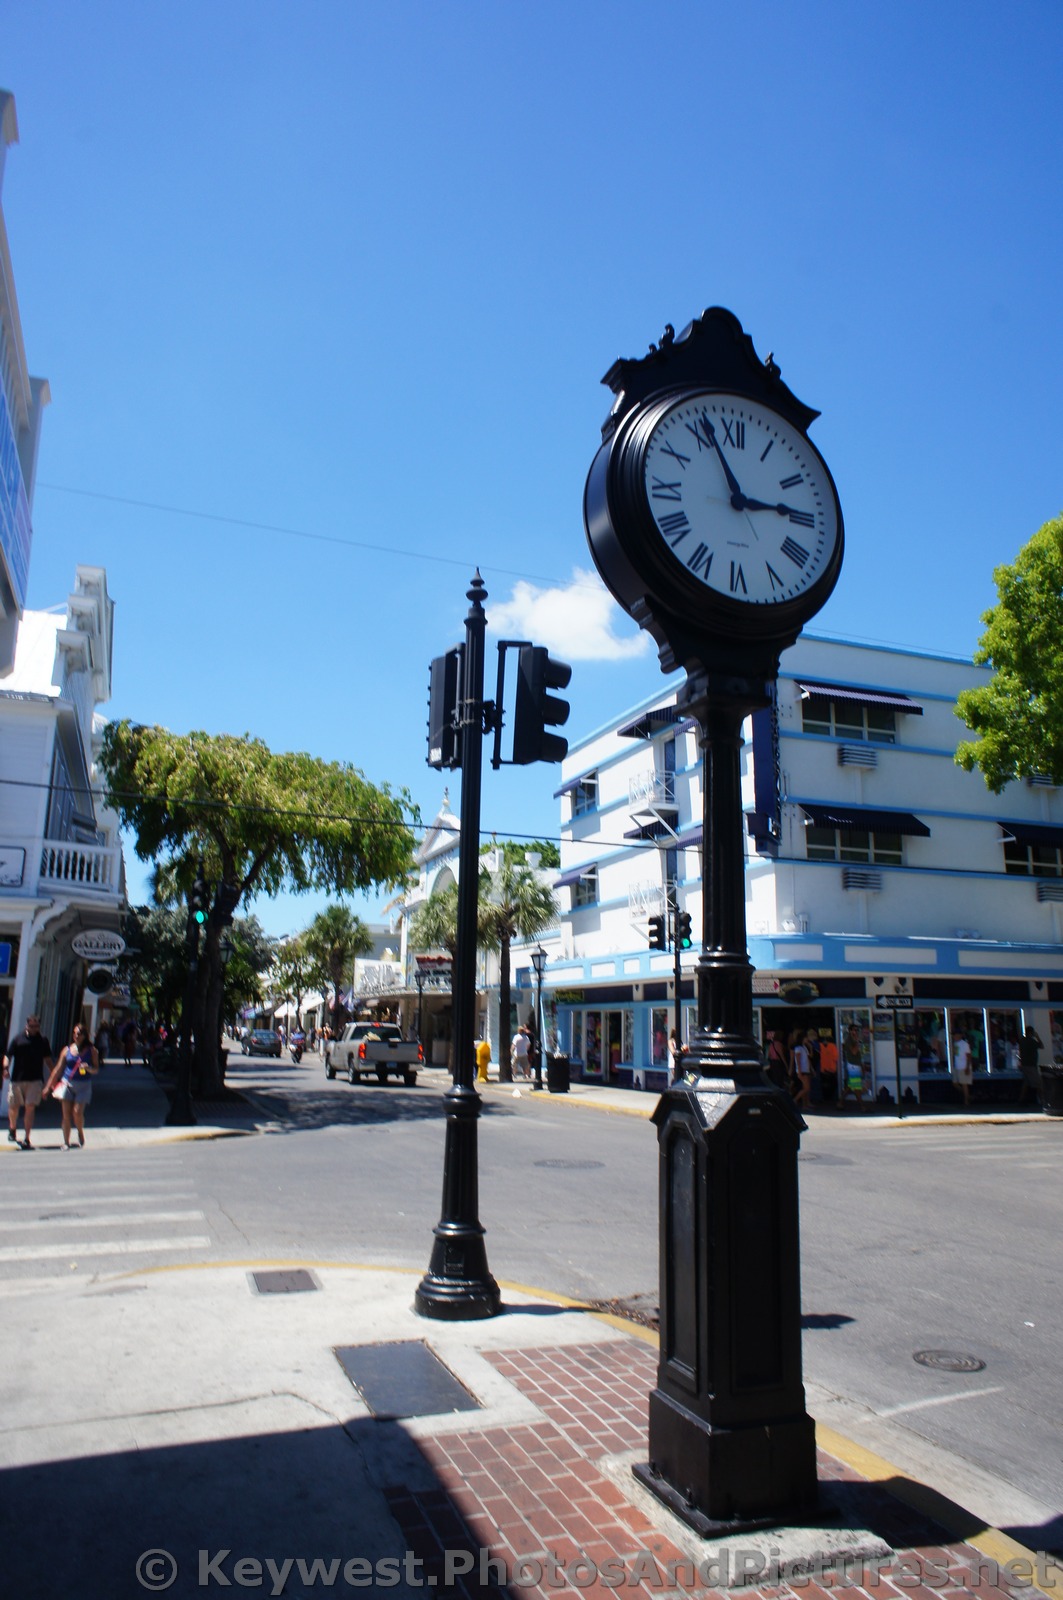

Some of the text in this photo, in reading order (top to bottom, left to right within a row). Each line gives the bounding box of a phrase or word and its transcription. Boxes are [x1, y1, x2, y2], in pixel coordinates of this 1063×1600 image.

[721, 417, 745, 450] XII
[660, 440, 691, 470] X
[760, 439, 774, 462] I
[652, 475, 682, 501] IX
[779, 473, 804, 490] II
[658, 511, 692, 548] VIII
[687, 542, 714, 580] VII
[780, 536, 810, 569] IIII
[730, 560, 748, 595] VI
[765, 560, 784, 590] V
[73, 941, 122, 950] GALLERY
[886, 997, 911, 1006] ONE WAY
